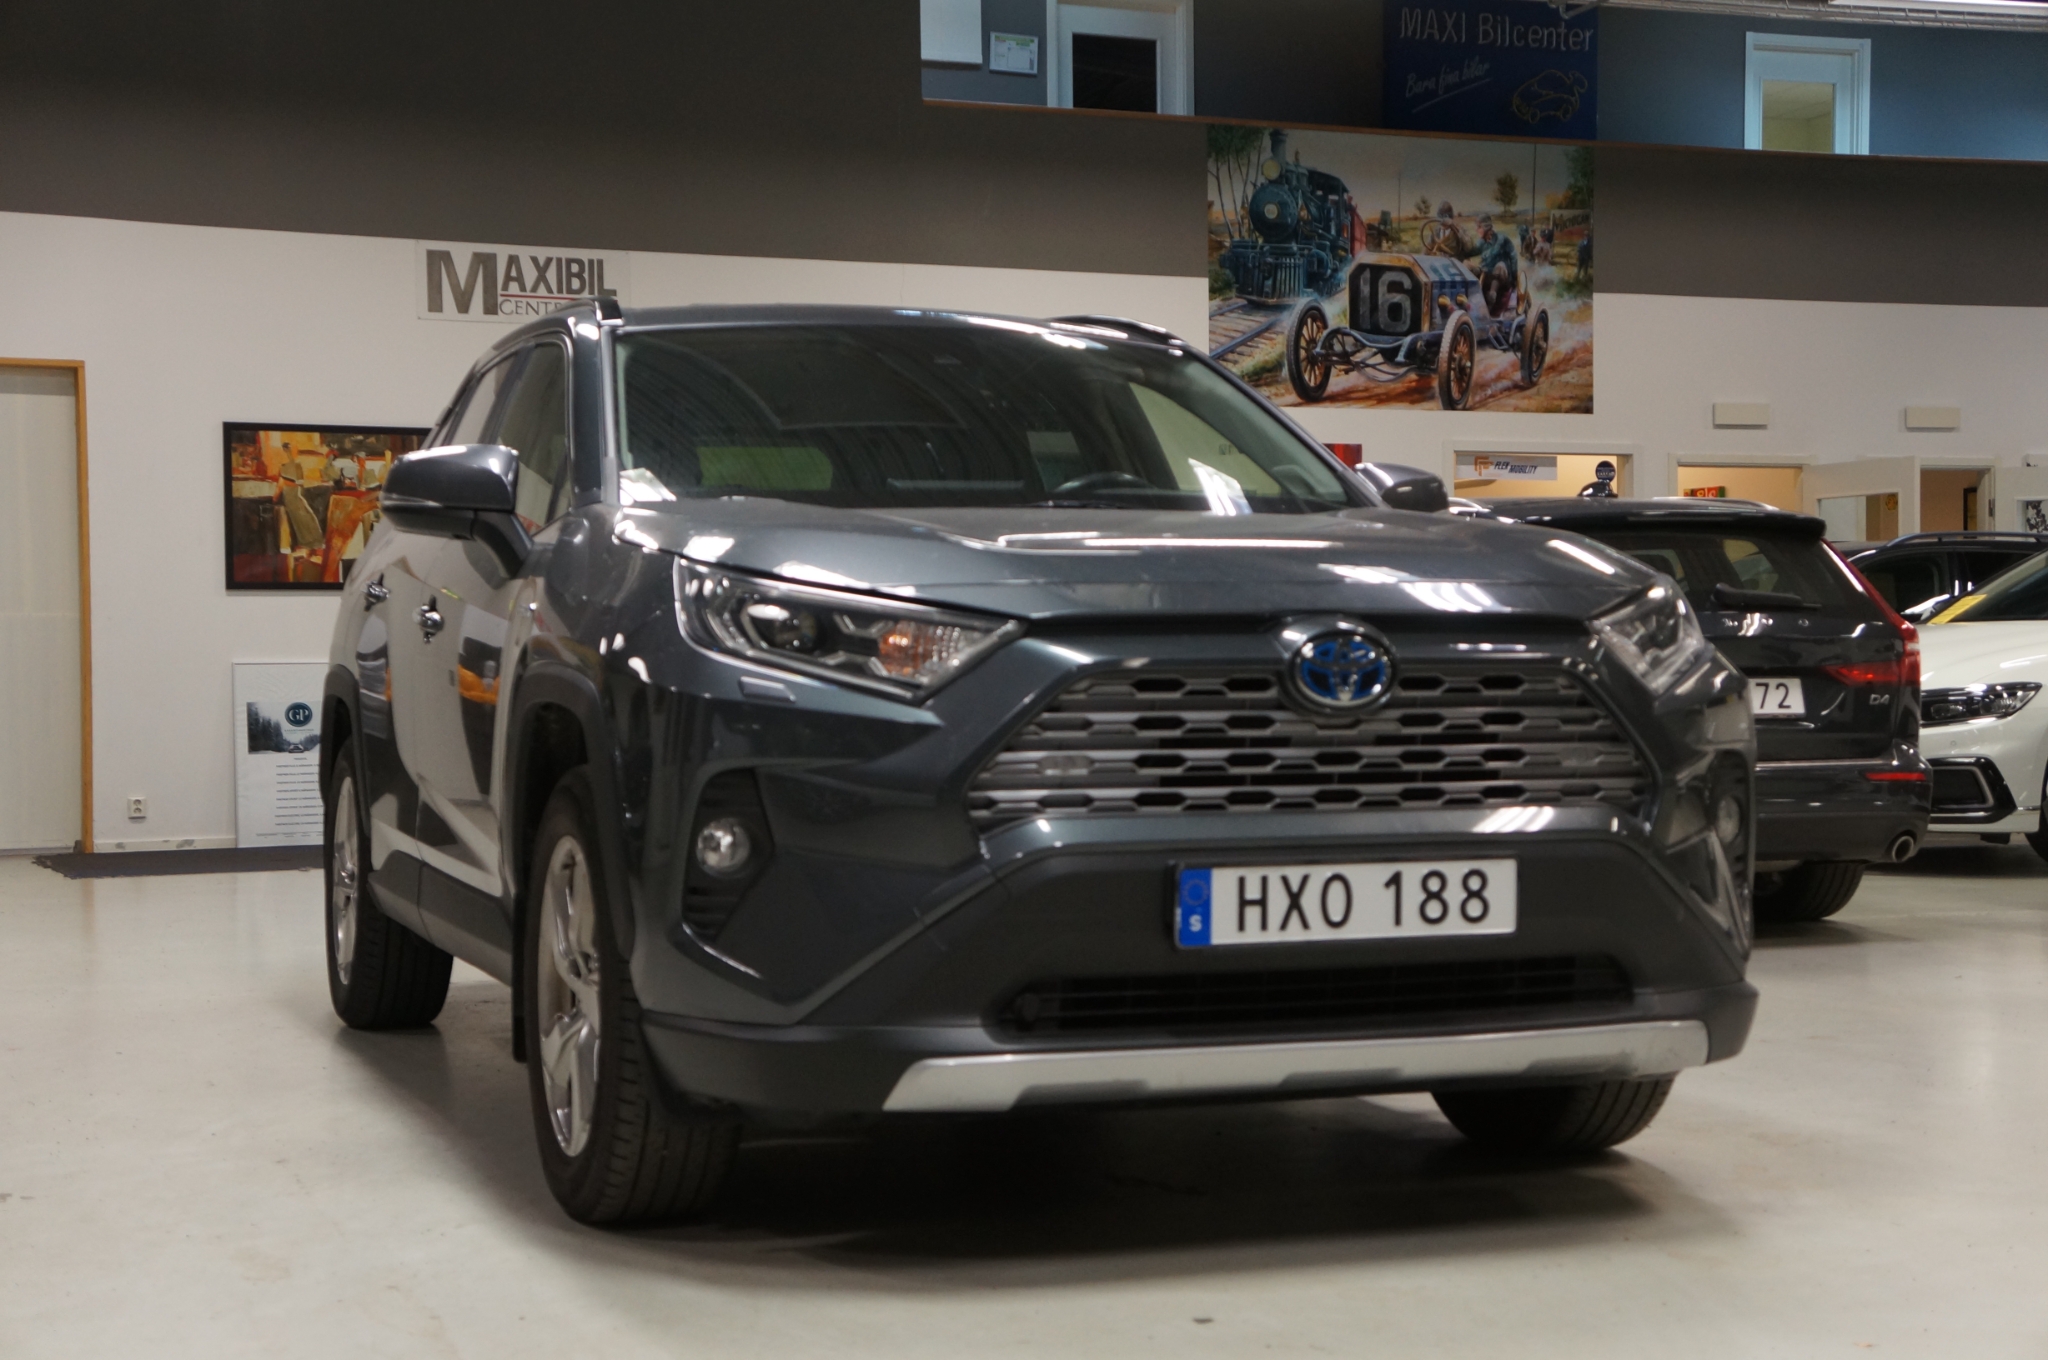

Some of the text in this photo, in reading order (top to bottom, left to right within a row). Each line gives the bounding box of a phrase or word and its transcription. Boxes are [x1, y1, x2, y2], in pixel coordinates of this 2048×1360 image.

[1400, 7, 1594, 50] MAXI Bilcenter
[1405, 72, 1437, 98] Bara
[426, 249, 617, 316] MAXIBIL
[1359, 267, 1413, 333] 16
[1508, 464, 1539, 475] MOBILITY
[1755, 682, 1792, 710] 72
[1869, 694, 1890, 706] D4
[288, 709, 310, 722] GP
[1238, 868, 1490, 932] HXO 188
[1188, 914, 1203, 933] S
